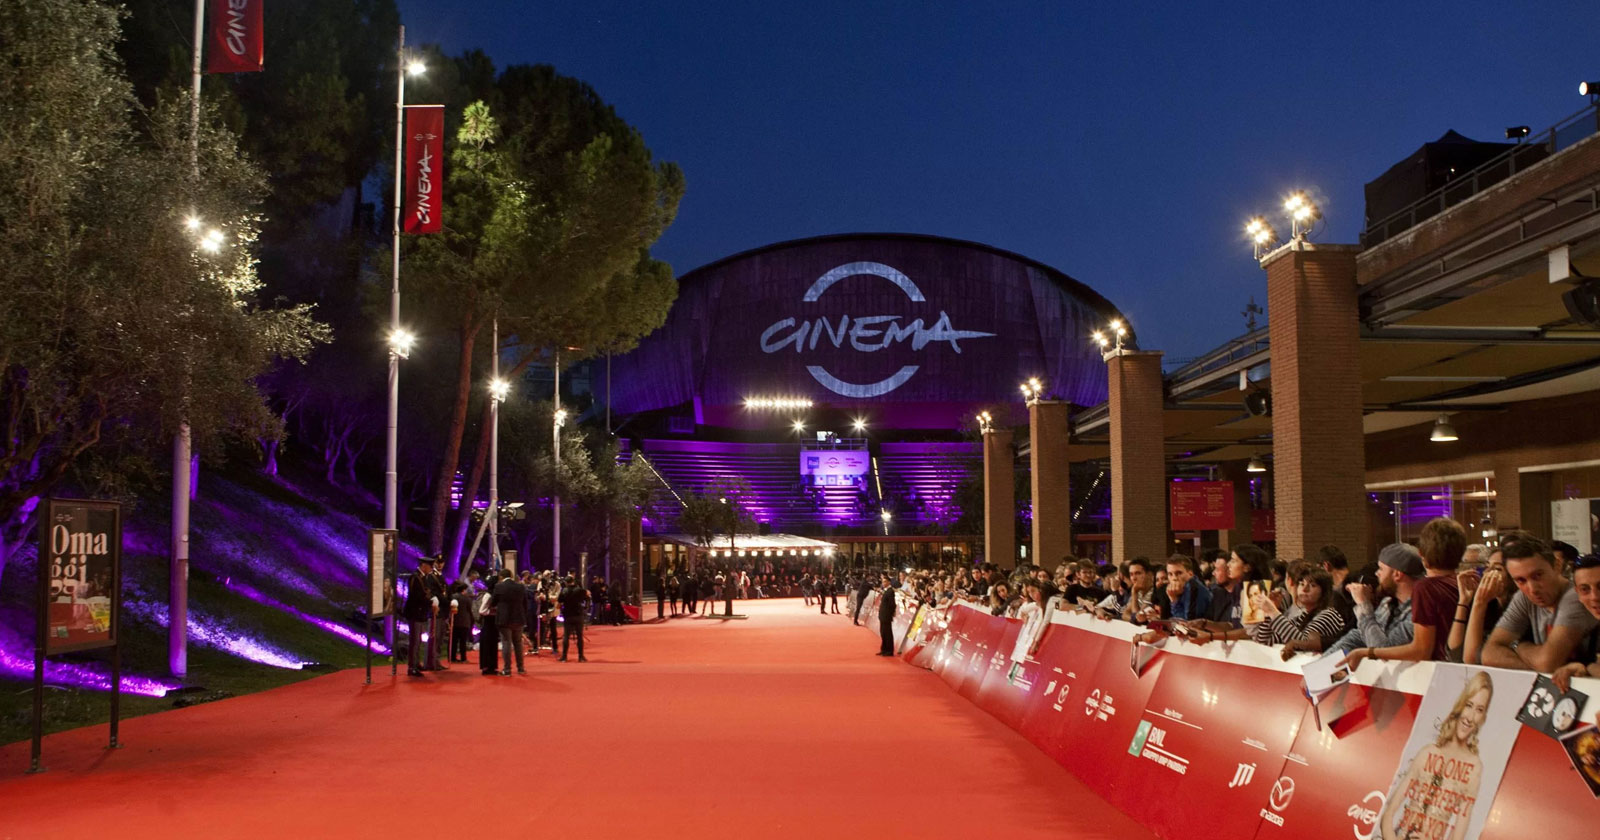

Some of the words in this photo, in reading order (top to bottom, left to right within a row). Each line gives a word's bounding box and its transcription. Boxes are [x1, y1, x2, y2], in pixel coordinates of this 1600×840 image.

[416, 144, 432, 224] CINEMA
[760, 310, 998, 354] CINEMA
[52, 524, 108, 555] Oma
[1148, 726, 1166, 747] BNL
[1424, 752, 1444, 776] NO
[1443, 758, 1474, 784] ONE
[1404, 778, 1420, 799] IS
[1418, 782, 1476, 817] PERFECT
